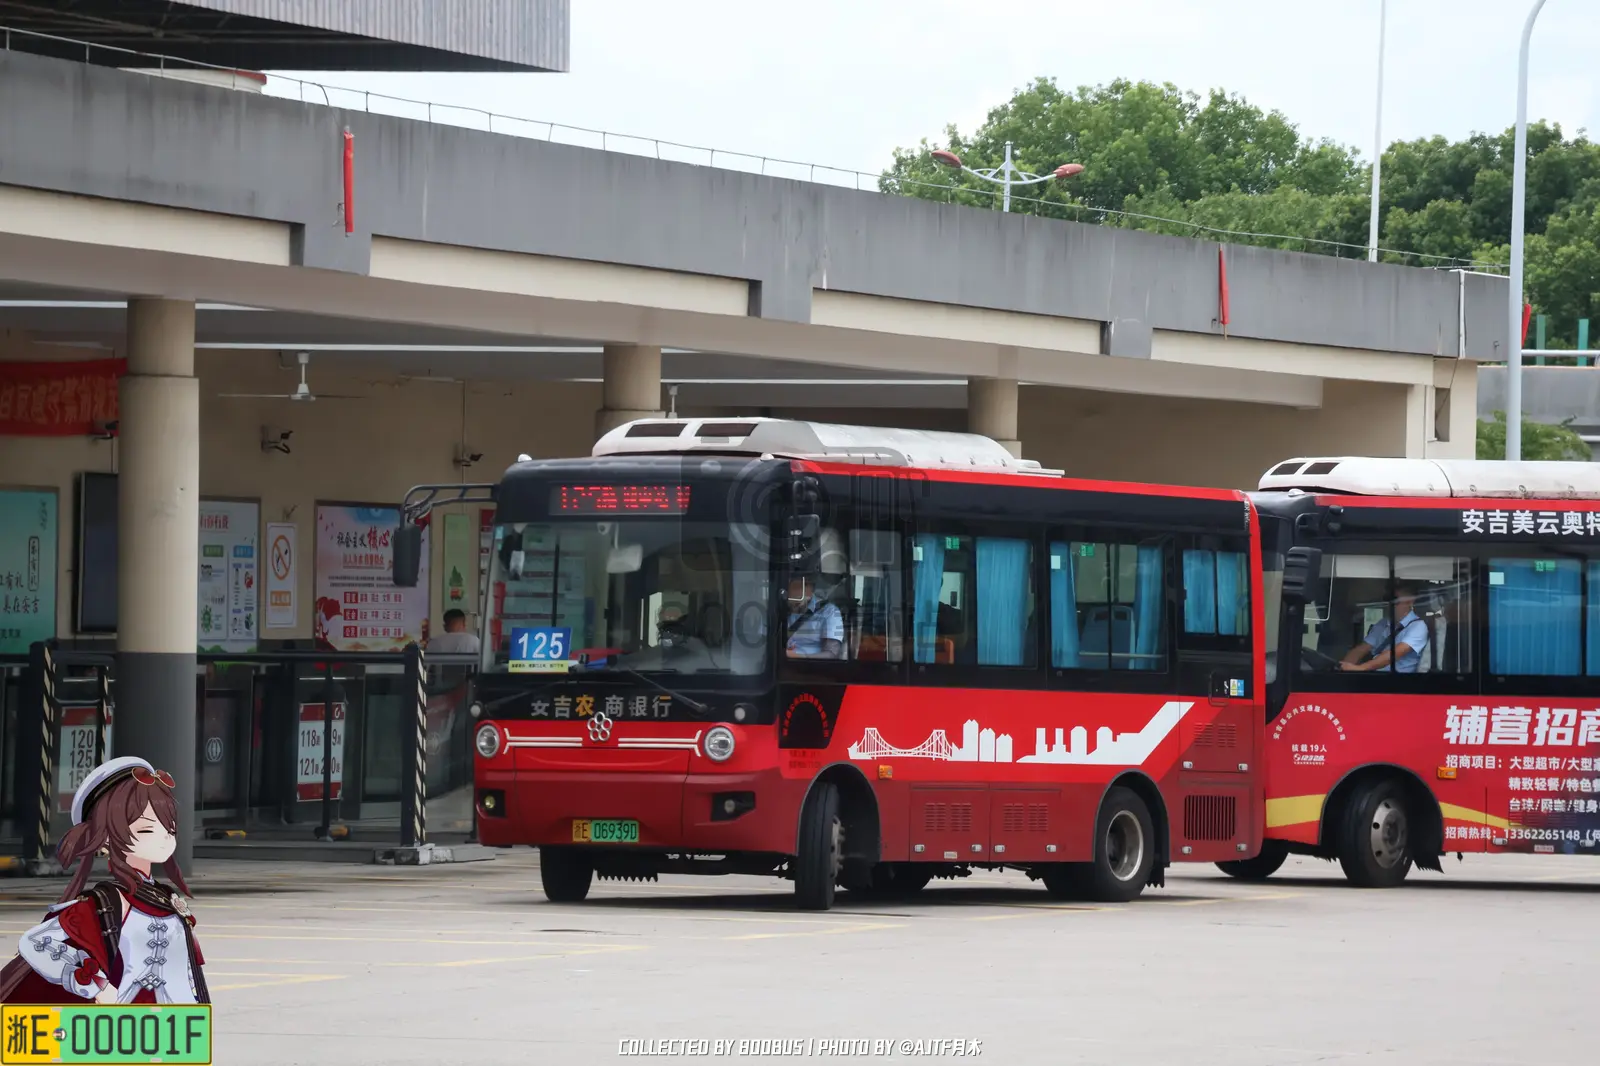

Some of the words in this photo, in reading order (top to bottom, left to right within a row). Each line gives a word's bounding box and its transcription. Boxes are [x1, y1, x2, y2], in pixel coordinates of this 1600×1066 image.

[1462, 508, 1600, 536] 安吉美云奥特
[337, 525, 394, 551] 社会主义核心
[518, 632, 563, 659] 125
[1509, 797, 1600, 814] 台球/网咖/健身
